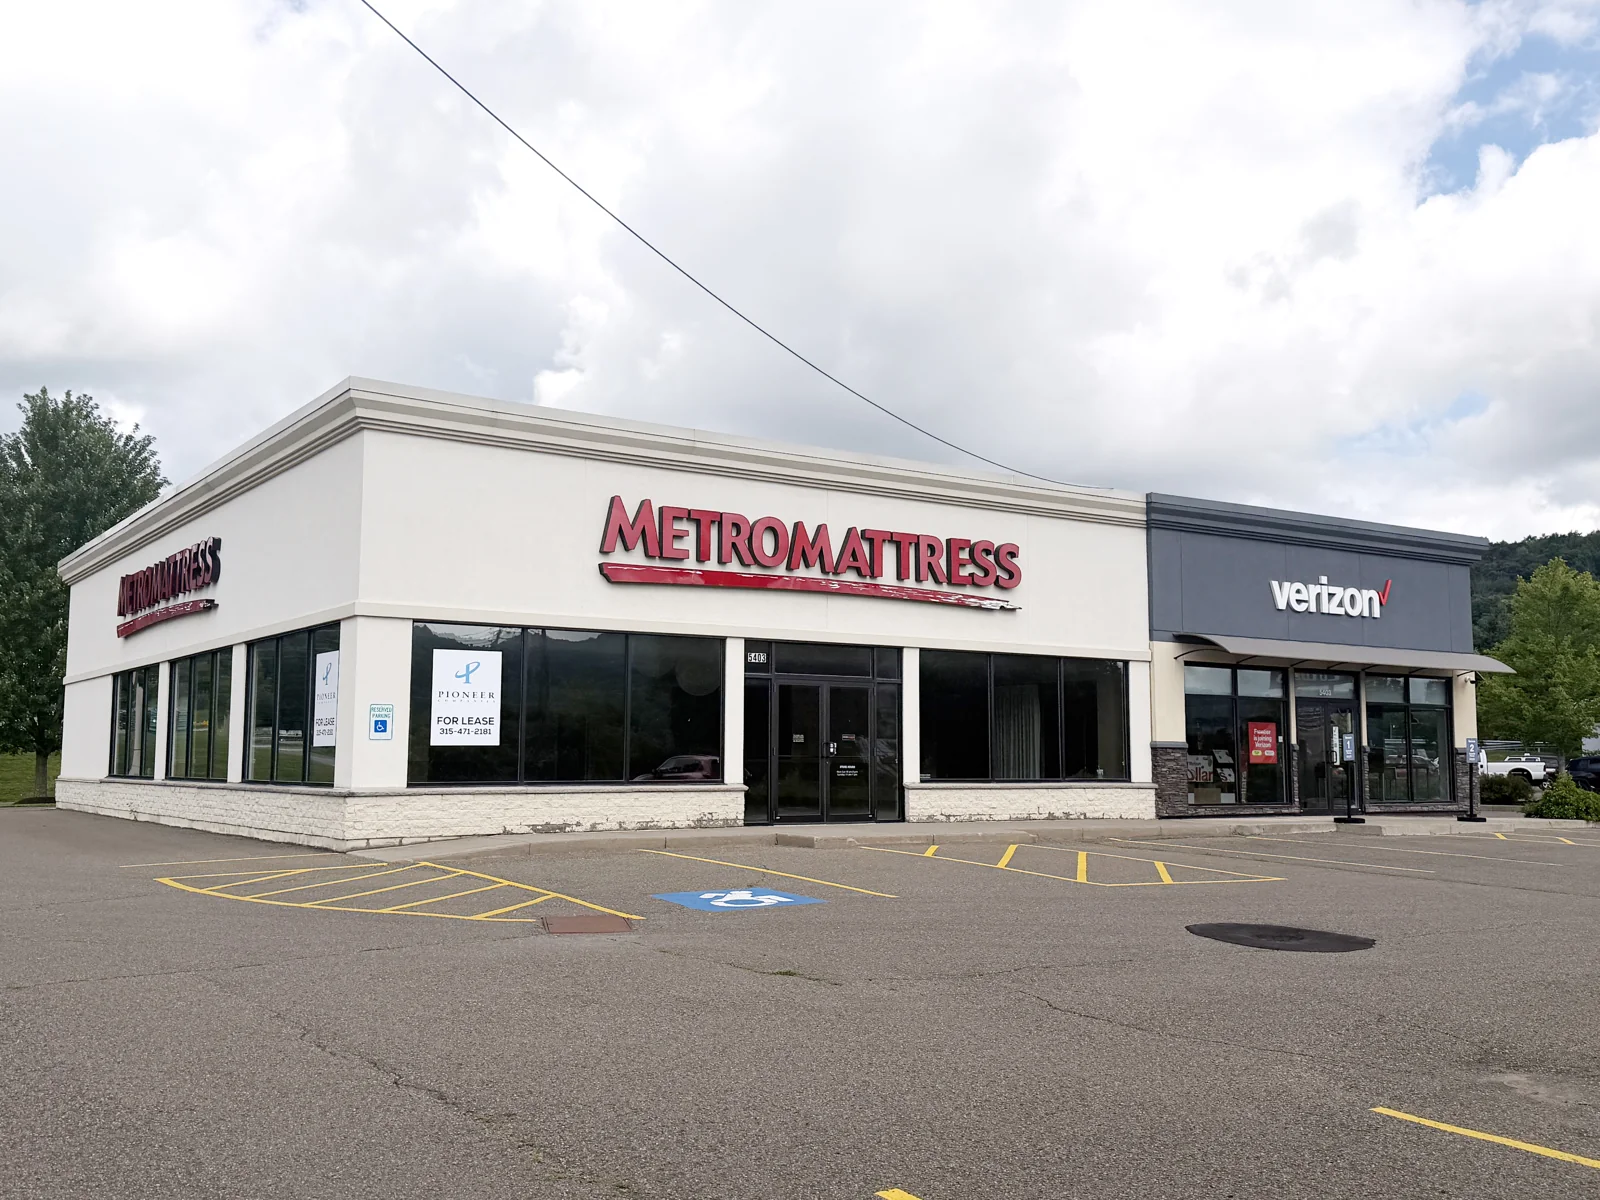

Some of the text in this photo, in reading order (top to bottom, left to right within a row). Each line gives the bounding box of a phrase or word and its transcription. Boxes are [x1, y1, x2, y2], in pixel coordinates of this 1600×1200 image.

[599, 495, 1022, 589] METROMATTRESS
[1269, 575, 1381, 618] verizon
[747, 652, 767, 663] 5403
[438, 690, 495, 699] PIONEER
[436, 716, 495, 726] FOR LEASE
[439, 727, 492, 735] 315-471-2181
[1346, 740, 1351, 750] 1
[1469, 743, 1475, 752] 2
